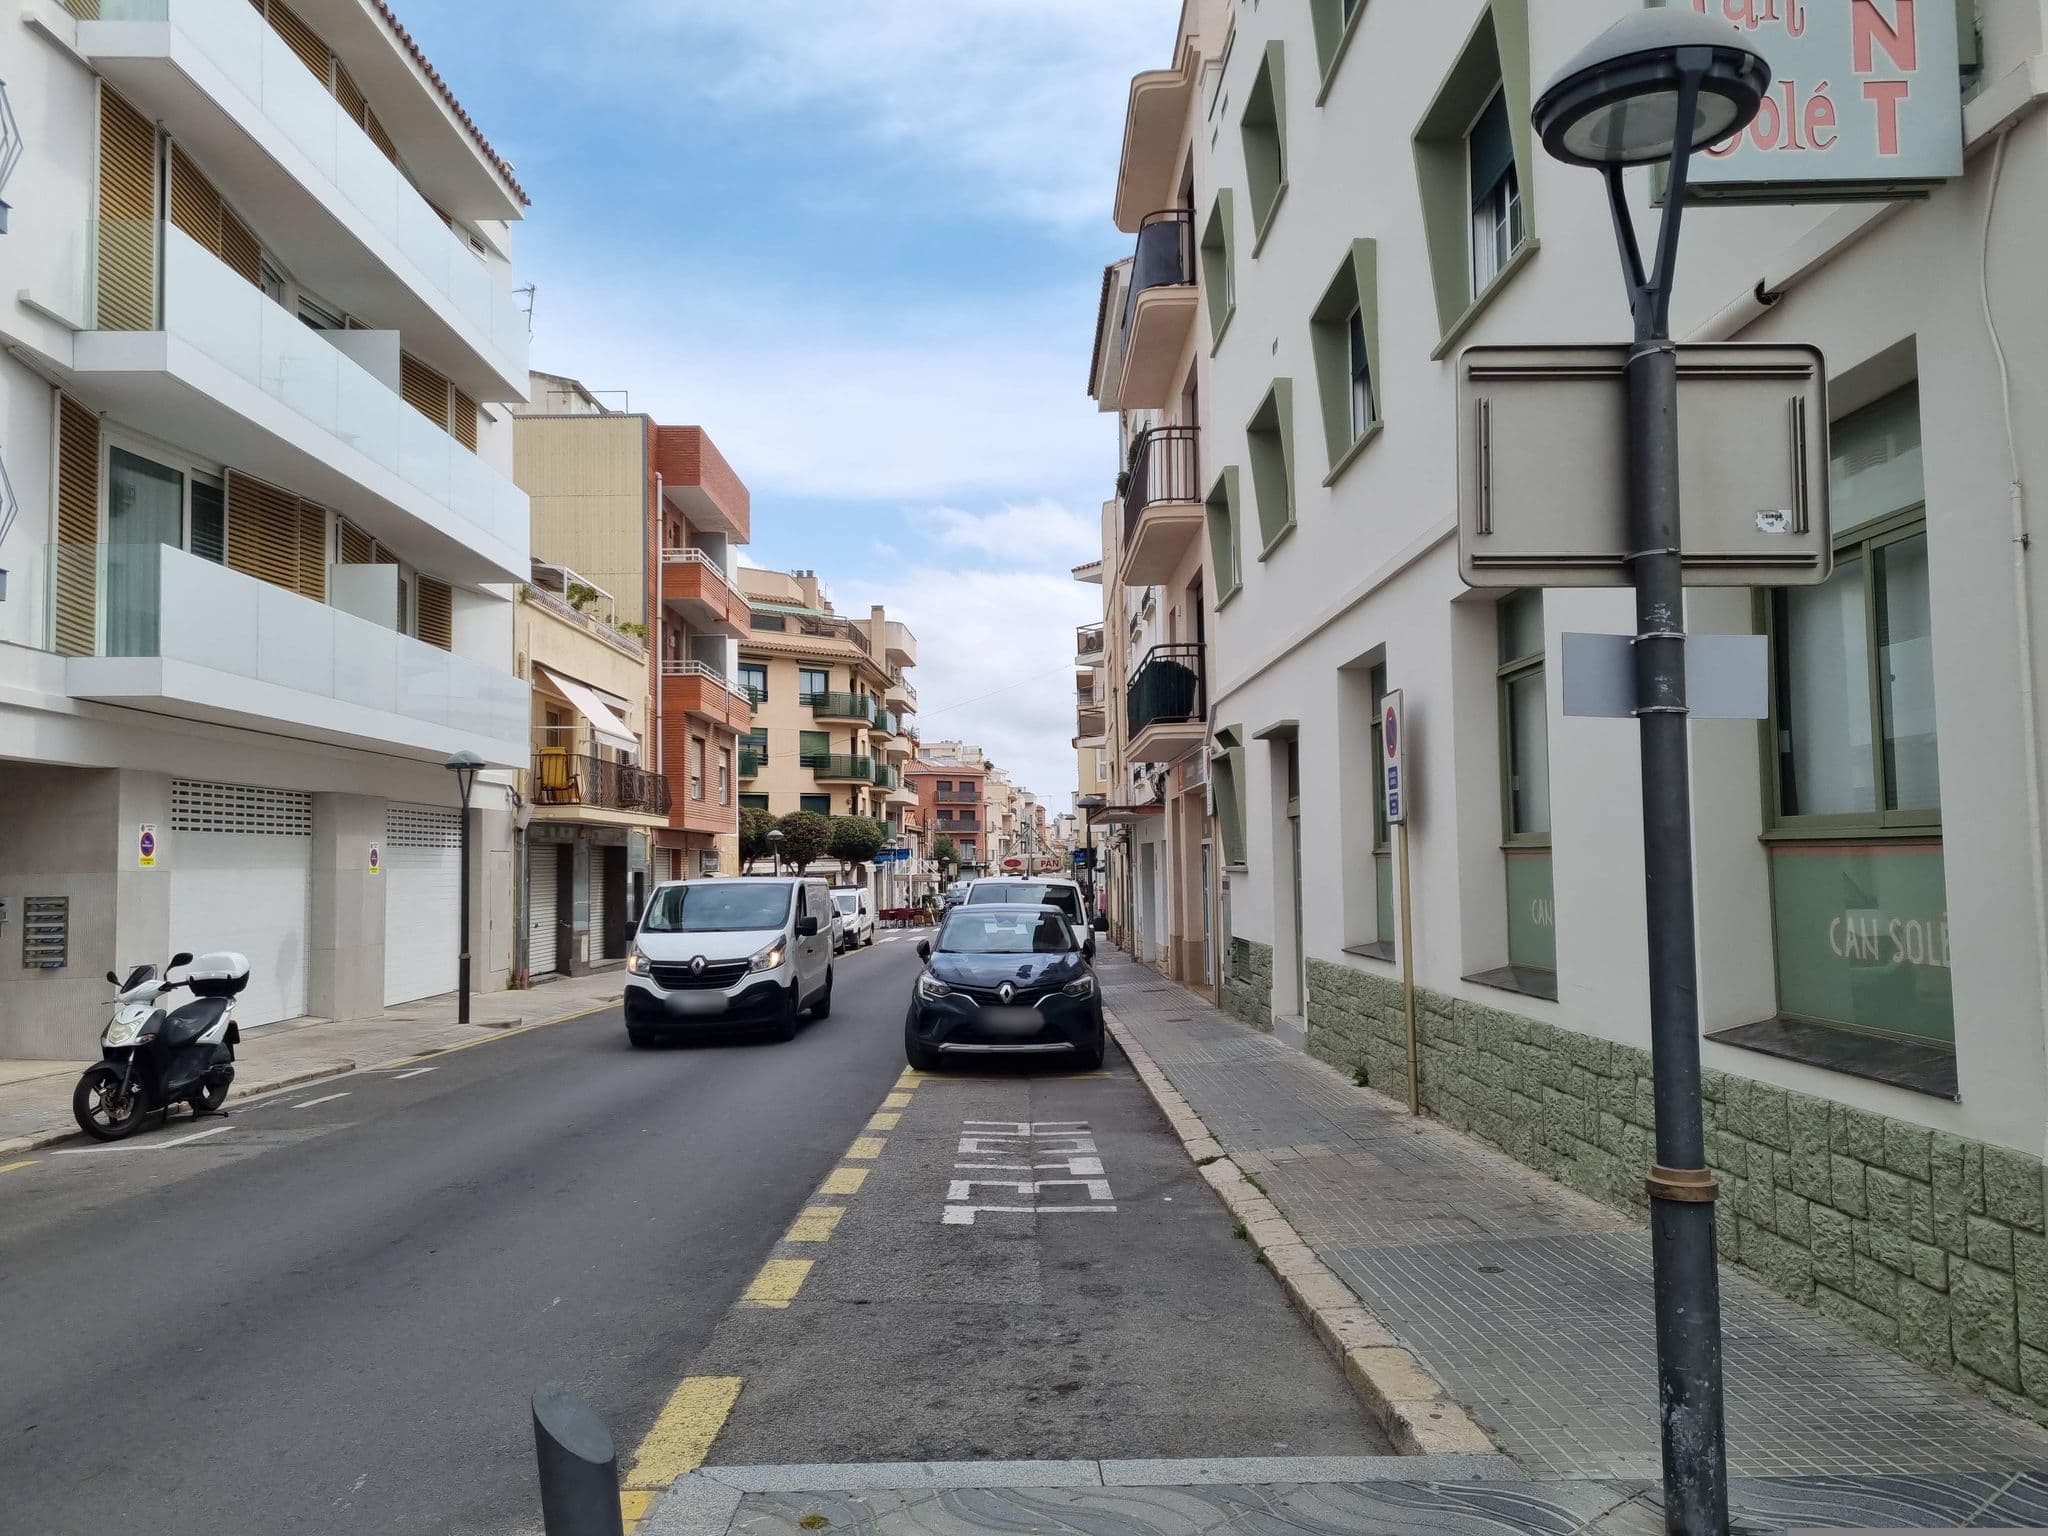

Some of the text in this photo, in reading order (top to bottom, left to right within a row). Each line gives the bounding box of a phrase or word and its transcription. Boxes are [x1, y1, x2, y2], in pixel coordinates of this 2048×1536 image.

[1703, 80, 1838, 157] olé
[1040, 860, 1059, 868] PAN
[1531, 898, 1553, 926] CAN
[1829, 916, 1879, 960] CAN
